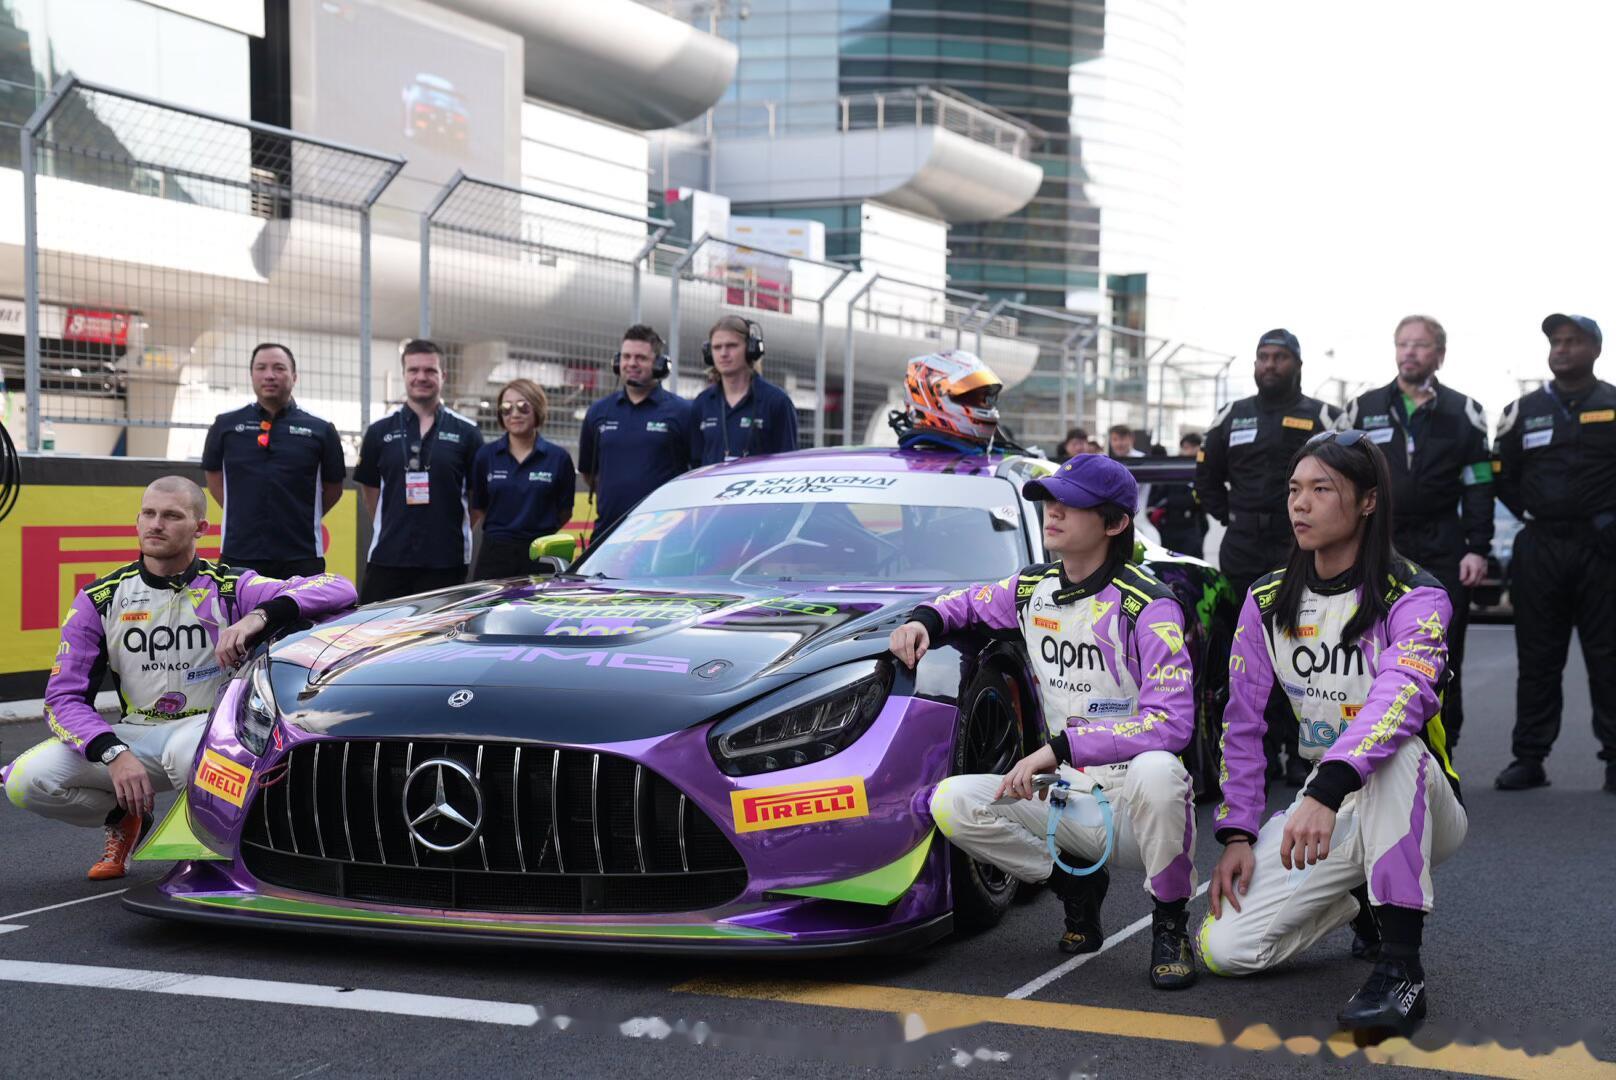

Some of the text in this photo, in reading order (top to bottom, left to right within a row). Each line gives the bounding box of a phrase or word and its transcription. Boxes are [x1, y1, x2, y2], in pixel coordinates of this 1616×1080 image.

[716, 475, 897, 498] 8 SHANGHAI
[748, 485, 834, 496] HOURS
[1123, 597, 1141, 613] OMP
[123, 623, 207, 661] apm
[440, 646, 691, 674] AMG
[1041, 635, 1106, 677] apm
[141, 662, 190, 672] MONACO
[1154, 684, 1185, 692] MONACO
[1306, 687, 1347, 701] ONACO
[1088, 703, 1098, 713] 8
[199, 760, 247, 799] PIRELLI
[743, 785, 855, 823] PIRELLI
